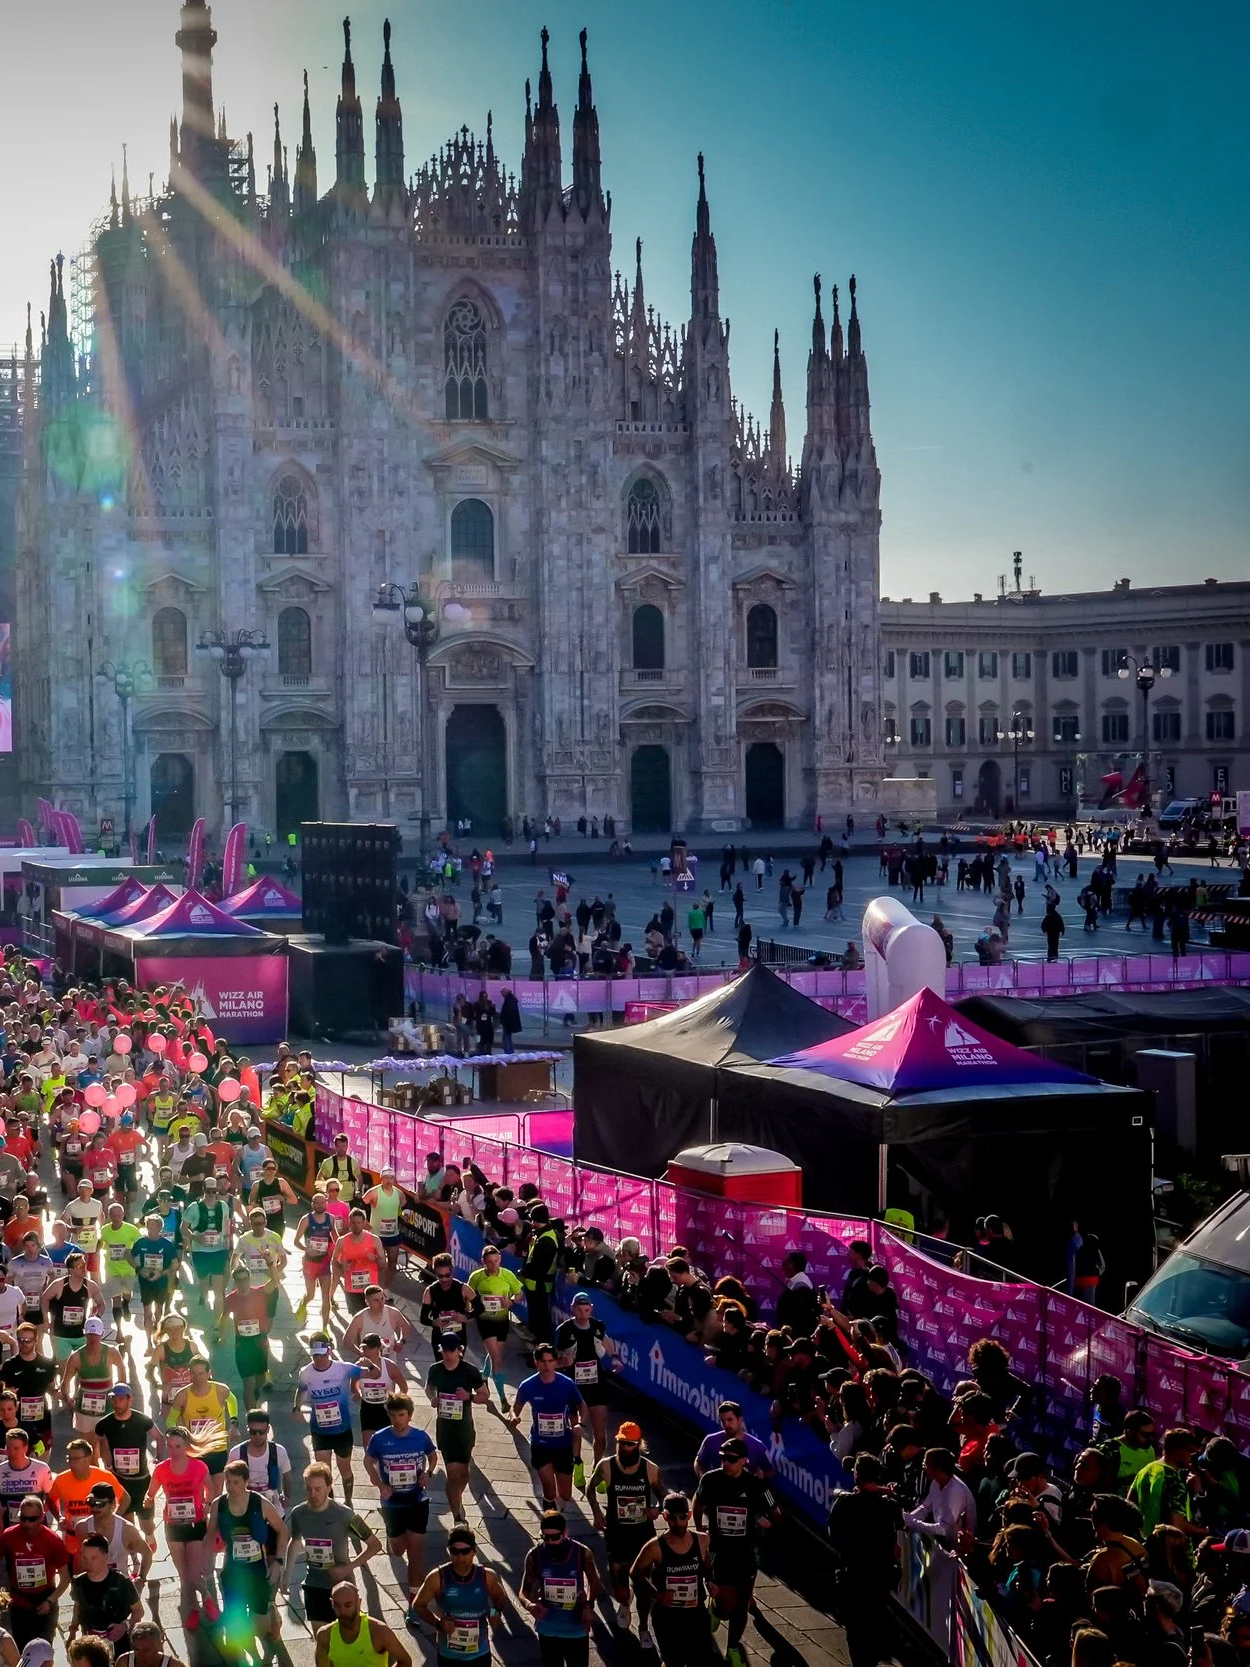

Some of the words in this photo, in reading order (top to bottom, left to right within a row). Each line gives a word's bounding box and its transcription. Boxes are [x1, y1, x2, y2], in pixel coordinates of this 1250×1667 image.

[219, 991, 245, 1000] WIZZ
[246, 991, 264, 1000] AIR
[219, 1000, 264, 1010] MILANO
[219, 1010, 264, 1018] MARATHON
[848, 1047, 878, 1057] MILANO
[951, 1053, 994, 1061] MILANO
[1, 1478, 38, 1486] clapham
[614, 1484, 646, 1492] RUNAWAY
[666, 1563, 700, 1573] RUNAWAY
